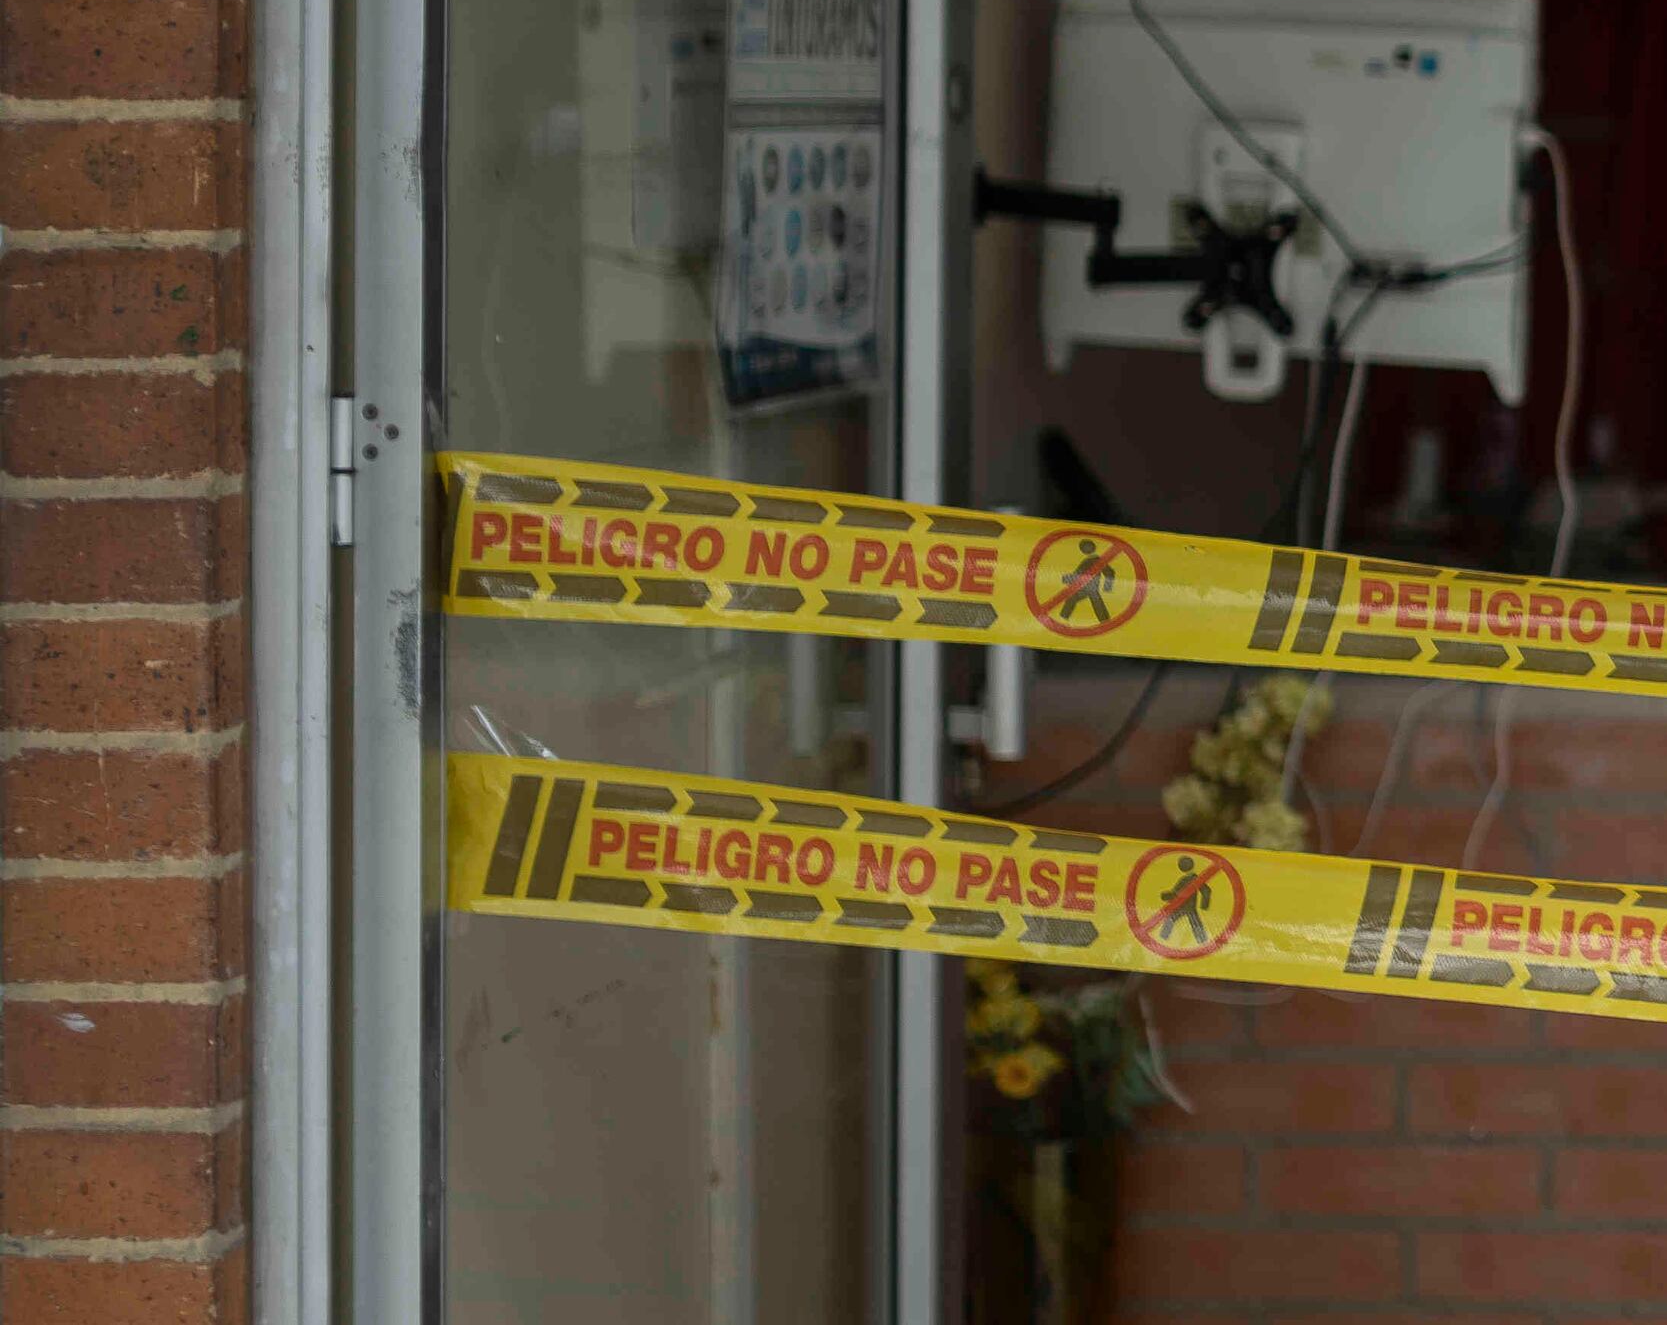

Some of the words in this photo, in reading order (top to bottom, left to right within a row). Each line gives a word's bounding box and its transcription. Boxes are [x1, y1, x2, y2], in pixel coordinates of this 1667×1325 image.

[472, 512, 724, 572] PELIGRO
[745, 531, 829, 580] NO
[849, 538, 998, 594] PASE
[1357, 579, 1607, 644] PELIGRO
[588, 819, 834, 886] PELIGRO
[856, 843, 937, 895] NO
[957, 852, 1099, 911] PASE
